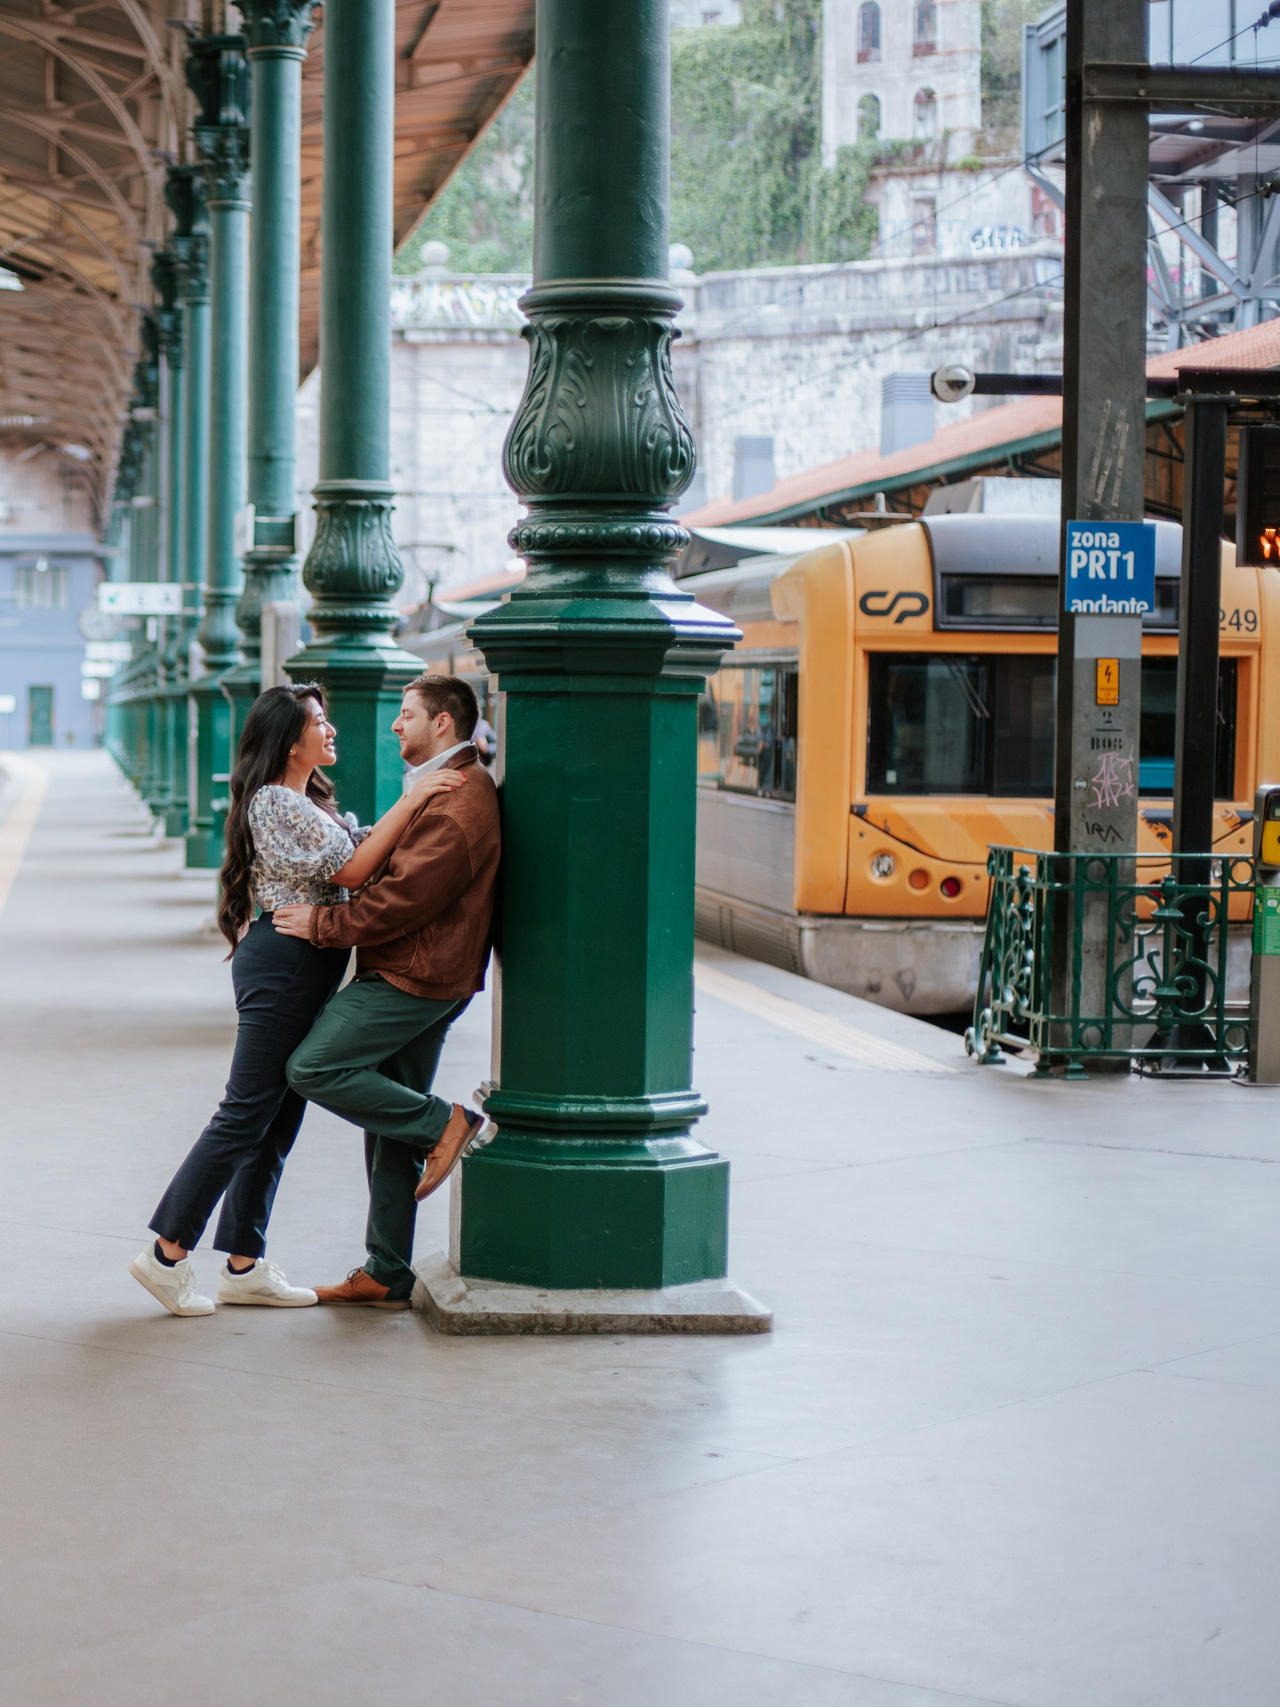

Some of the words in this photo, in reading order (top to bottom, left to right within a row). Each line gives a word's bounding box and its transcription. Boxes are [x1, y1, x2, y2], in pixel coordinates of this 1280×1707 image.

[1071, 531, 1120, 548] zona
[1070, 549, 1135, 580] PRT1
[1070, 594, 1149, 614] andante
